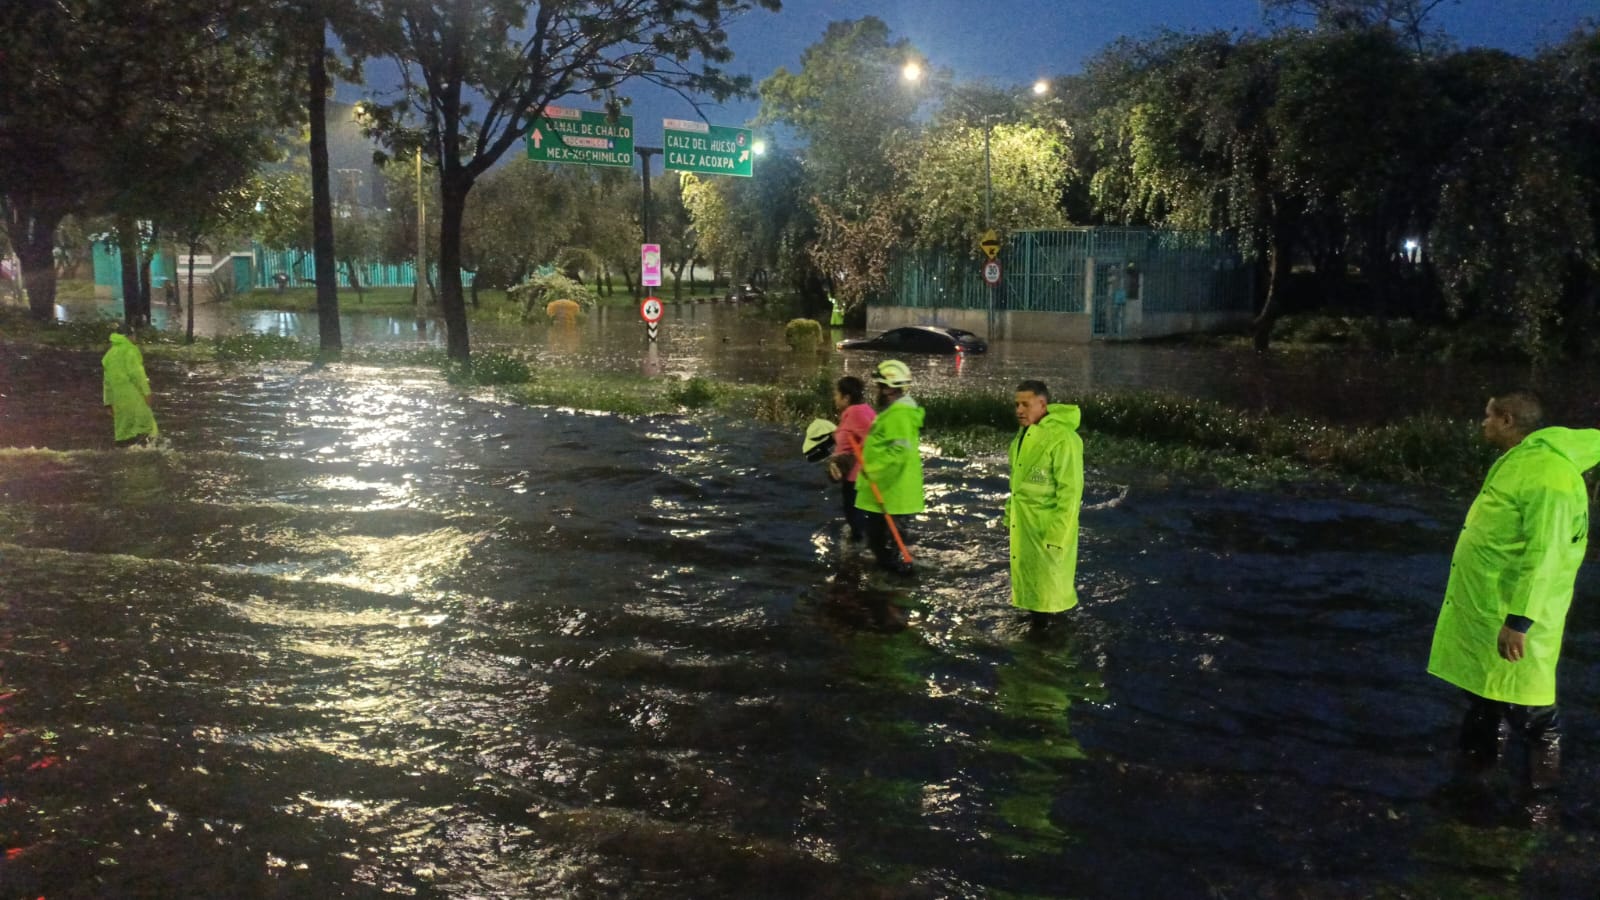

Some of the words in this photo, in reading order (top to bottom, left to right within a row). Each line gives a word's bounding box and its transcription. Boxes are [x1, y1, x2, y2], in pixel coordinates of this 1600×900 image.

[546, 122, 579, 133] CANAL
[581, 125, 593, 135] DE
[596, 126, 630, 138] CHALCO
[667, 136, 690, 149] CALZ
[692, 138, 707, 151] DEL
[710, 141, 736, 153] HUESO
[669, 152, 696, 166] CALZ
[699, 155, 735, 169] ACOXPA
